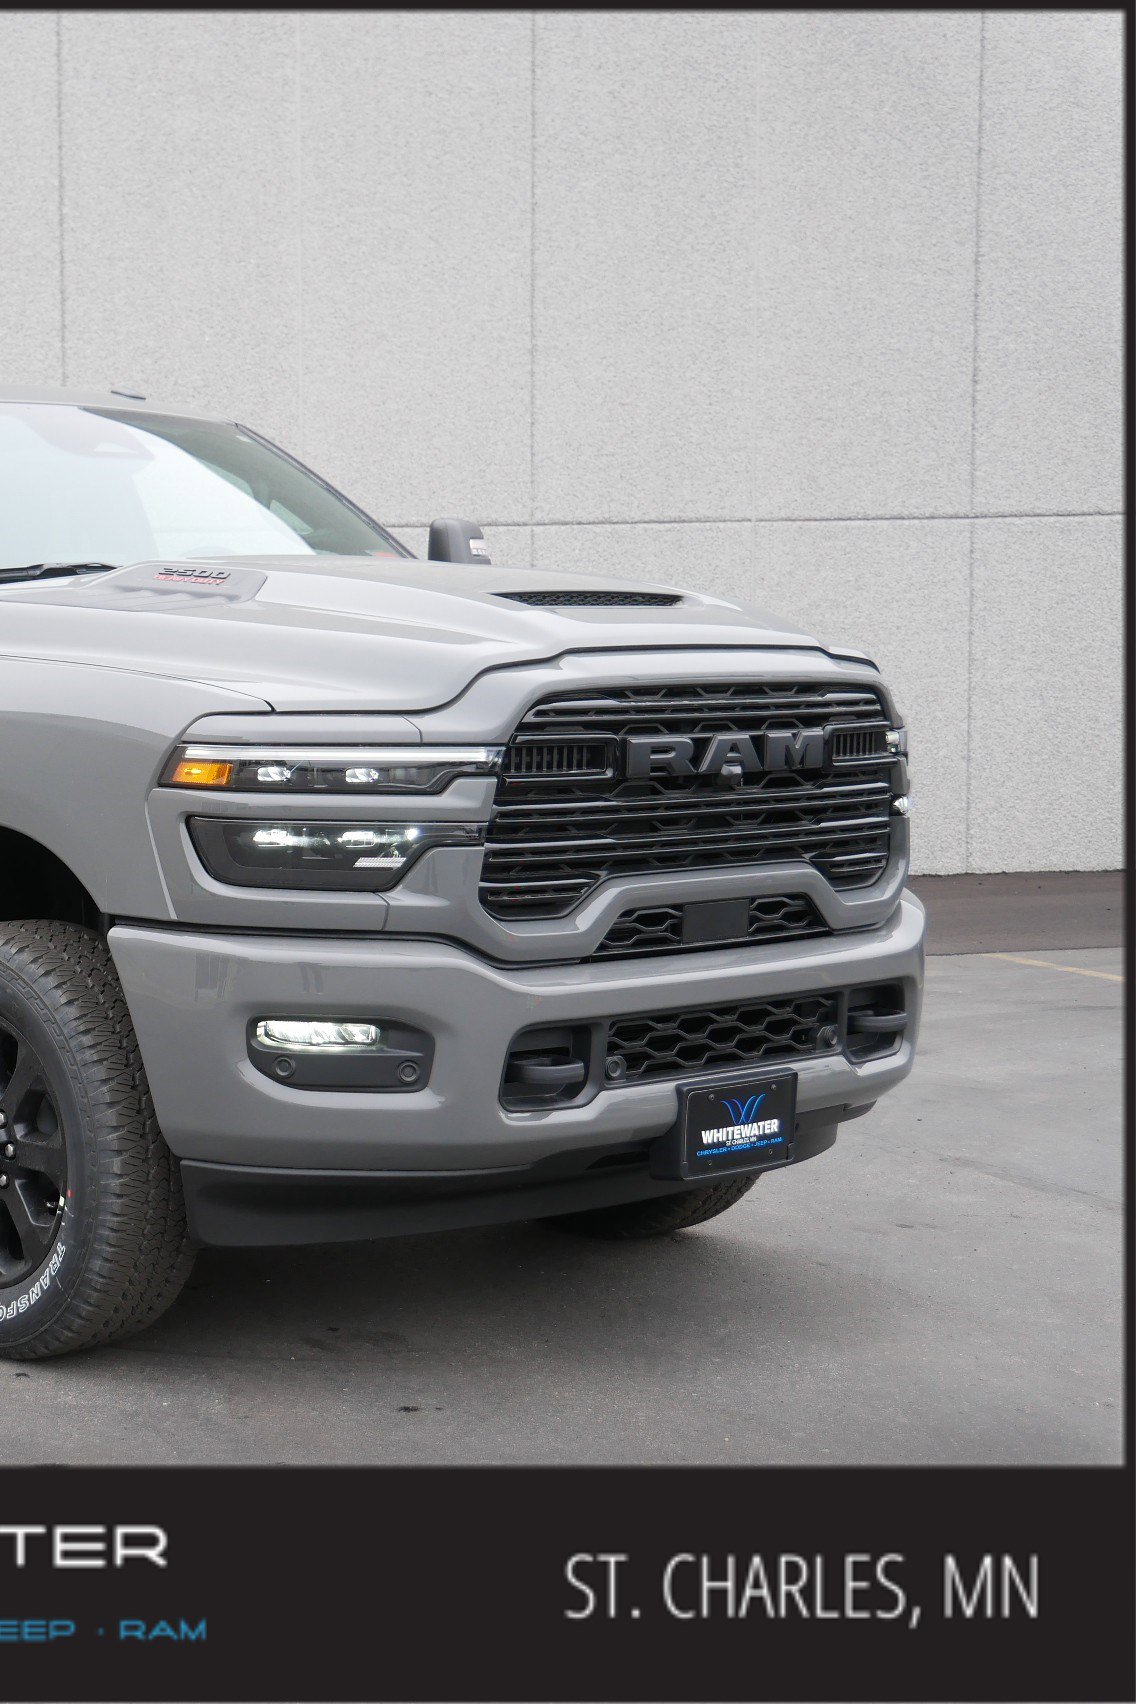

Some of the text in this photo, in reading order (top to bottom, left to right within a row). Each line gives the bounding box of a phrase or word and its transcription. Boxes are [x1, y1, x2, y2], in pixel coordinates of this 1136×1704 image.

[158, 567, 231, 579] 2500
[626, 727, 824, 777] RAM
[701, 1118, 779, 1144] WHITEWATER
[696, 1136, 783, 1156] CHRYSLER DODGE JEEP RAM
